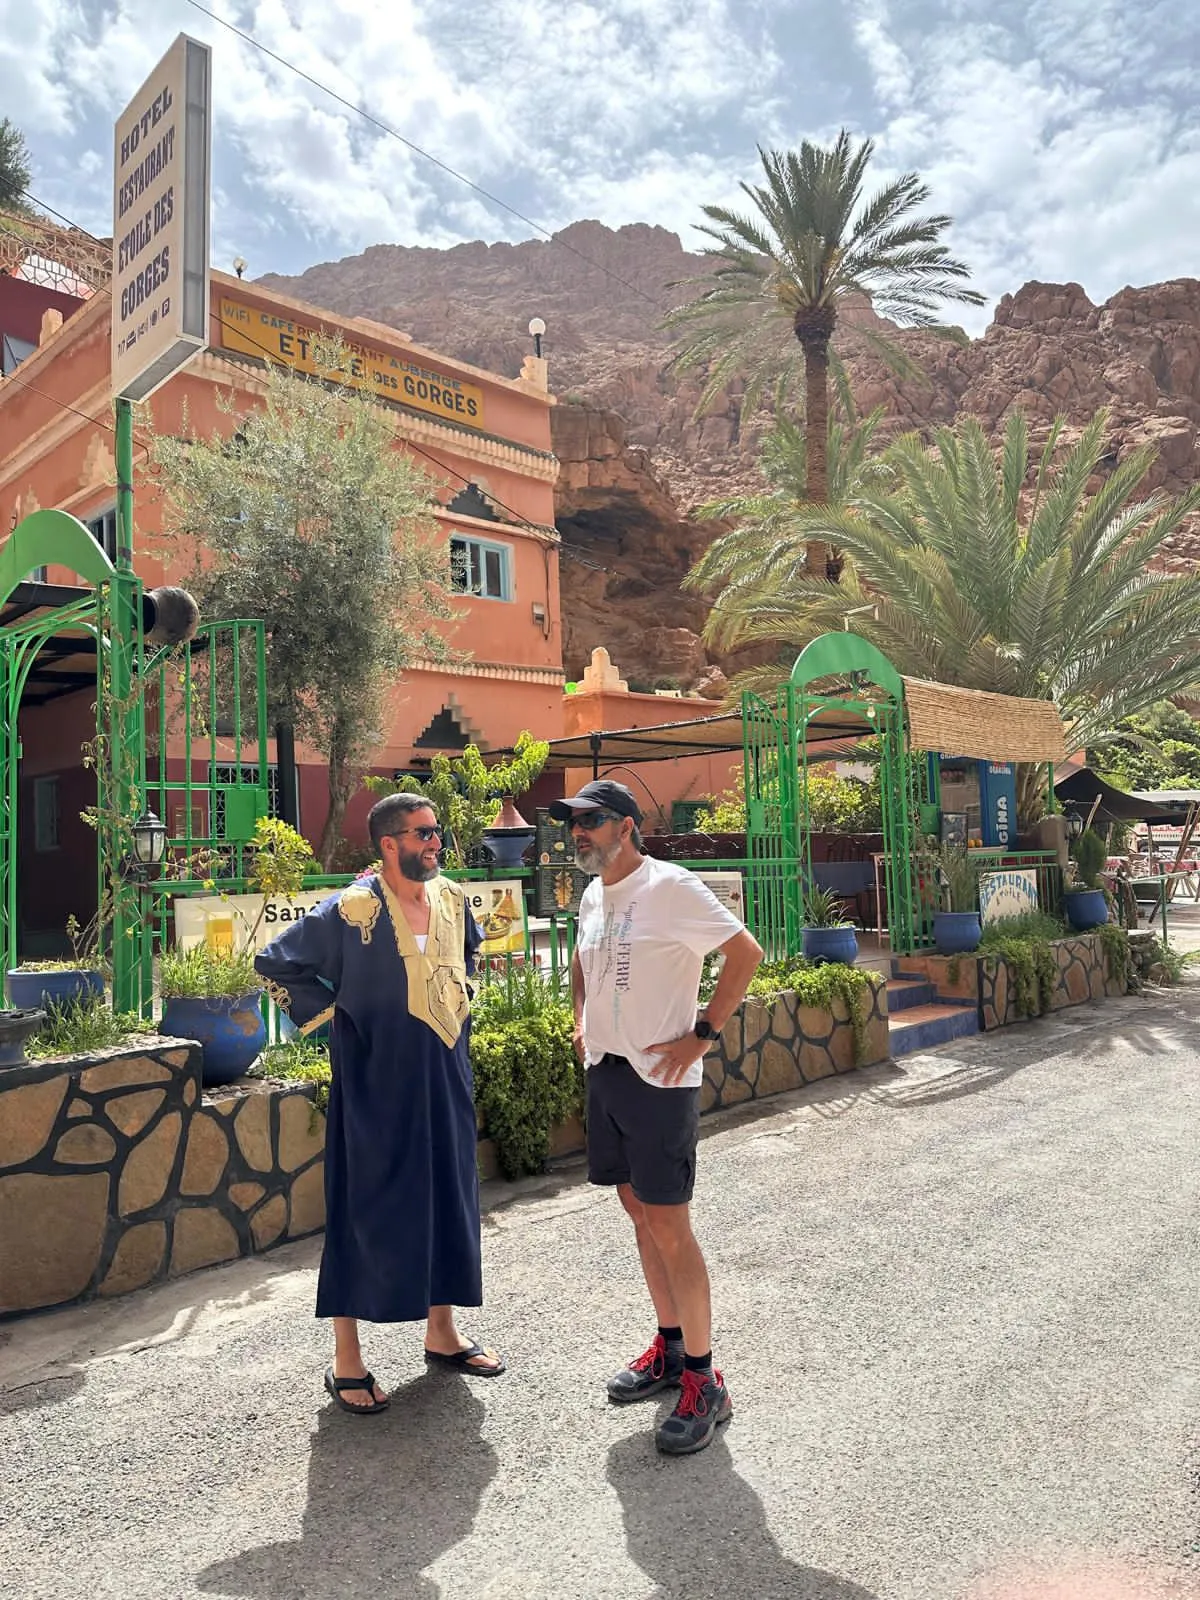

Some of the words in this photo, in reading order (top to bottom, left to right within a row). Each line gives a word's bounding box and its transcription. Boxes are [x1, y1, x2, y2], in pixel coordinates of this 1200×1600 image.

[120, 85, 173, 168] HOTEL
[119, 125, 175, 219] RESTAURANT
[119, 209, 152, 275] ETOILE
[154, 185, 173, 236] DES
[121, 245, 169, 322] GORGES
[372, 369, 399, 389] DES
[403, 375, 478, 417] GORGES
[389, 358, 463, 392] AUBERGE
[995, 795, 1009, 850] GINA
